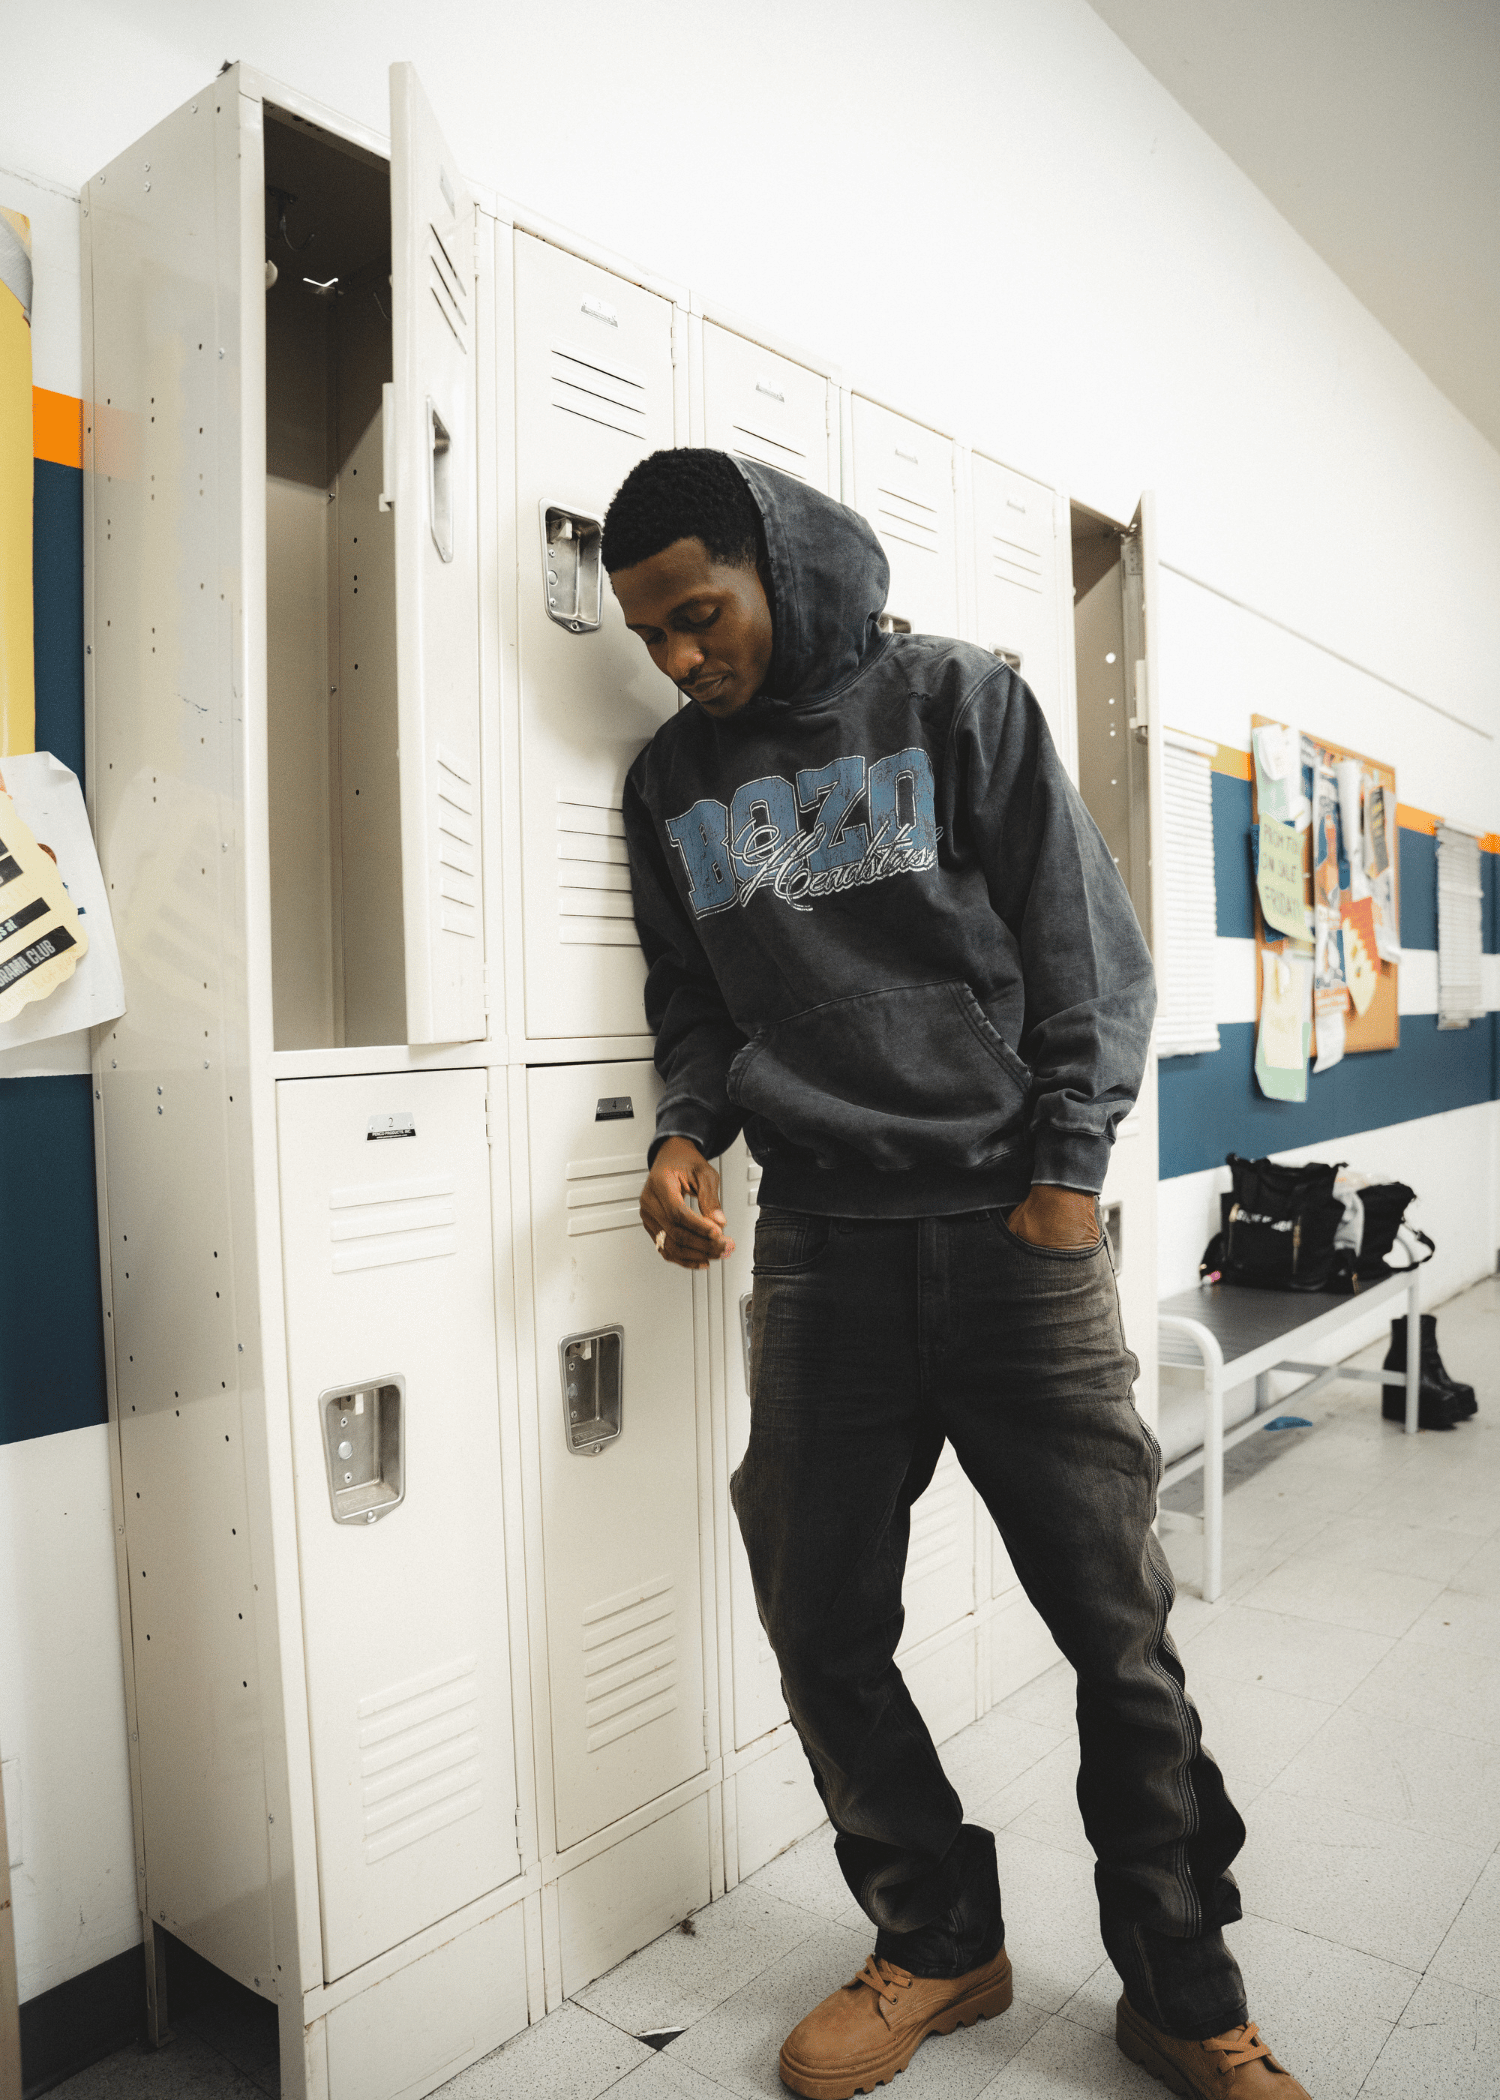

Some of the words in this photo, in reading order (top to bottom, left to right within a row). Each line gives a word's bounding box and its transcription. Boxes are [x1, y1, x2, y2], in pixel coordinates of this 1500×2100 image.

[666, 747, 937, 919] BOZO
[25, 939, 56, 965] CLUB
[612, 1100, 617, 1110] 4
[388, 1117, 394, 1128] 2
